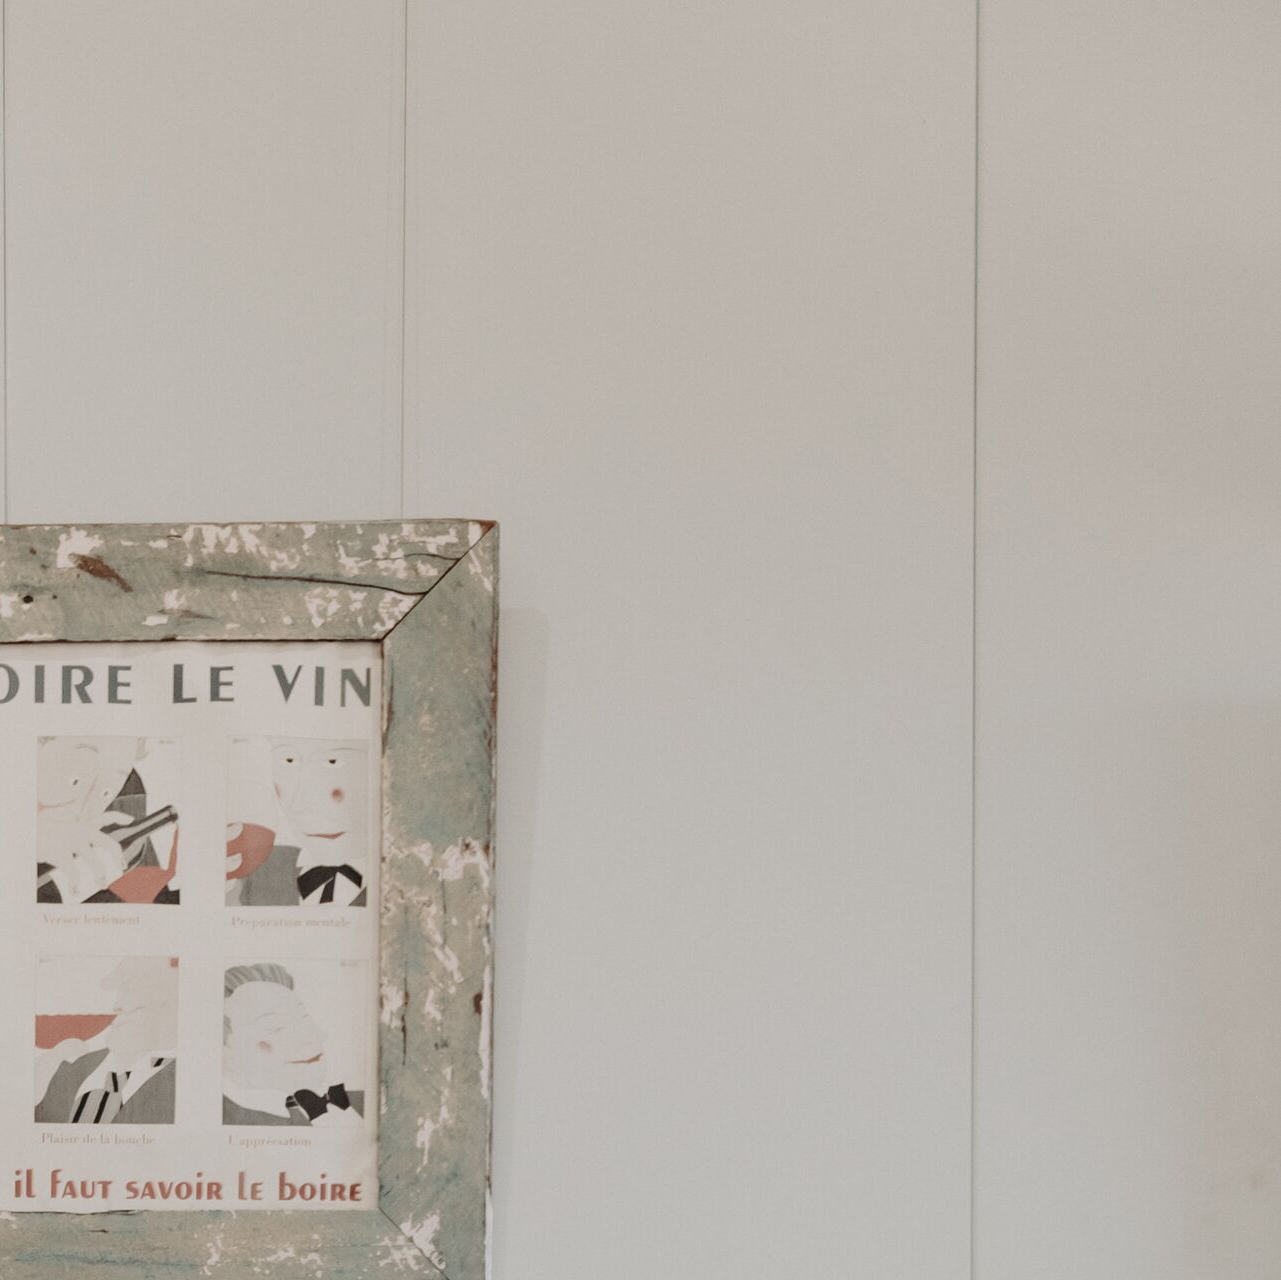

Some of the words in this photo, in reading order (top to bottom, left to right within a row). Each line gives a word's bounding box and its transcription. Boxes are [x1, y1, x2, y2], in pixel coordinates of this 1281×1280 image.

[172, 663, 236, 704] LE
[271, 664, 372, 708] VIN
[14, 1168, 37, 1200] il
[49, 1169, 114, 1200] faut
[125, 1171, 223, 1201] savoir
[238, 1171, 265, 1201] le
[278, 1171, 364, 1202] boire
